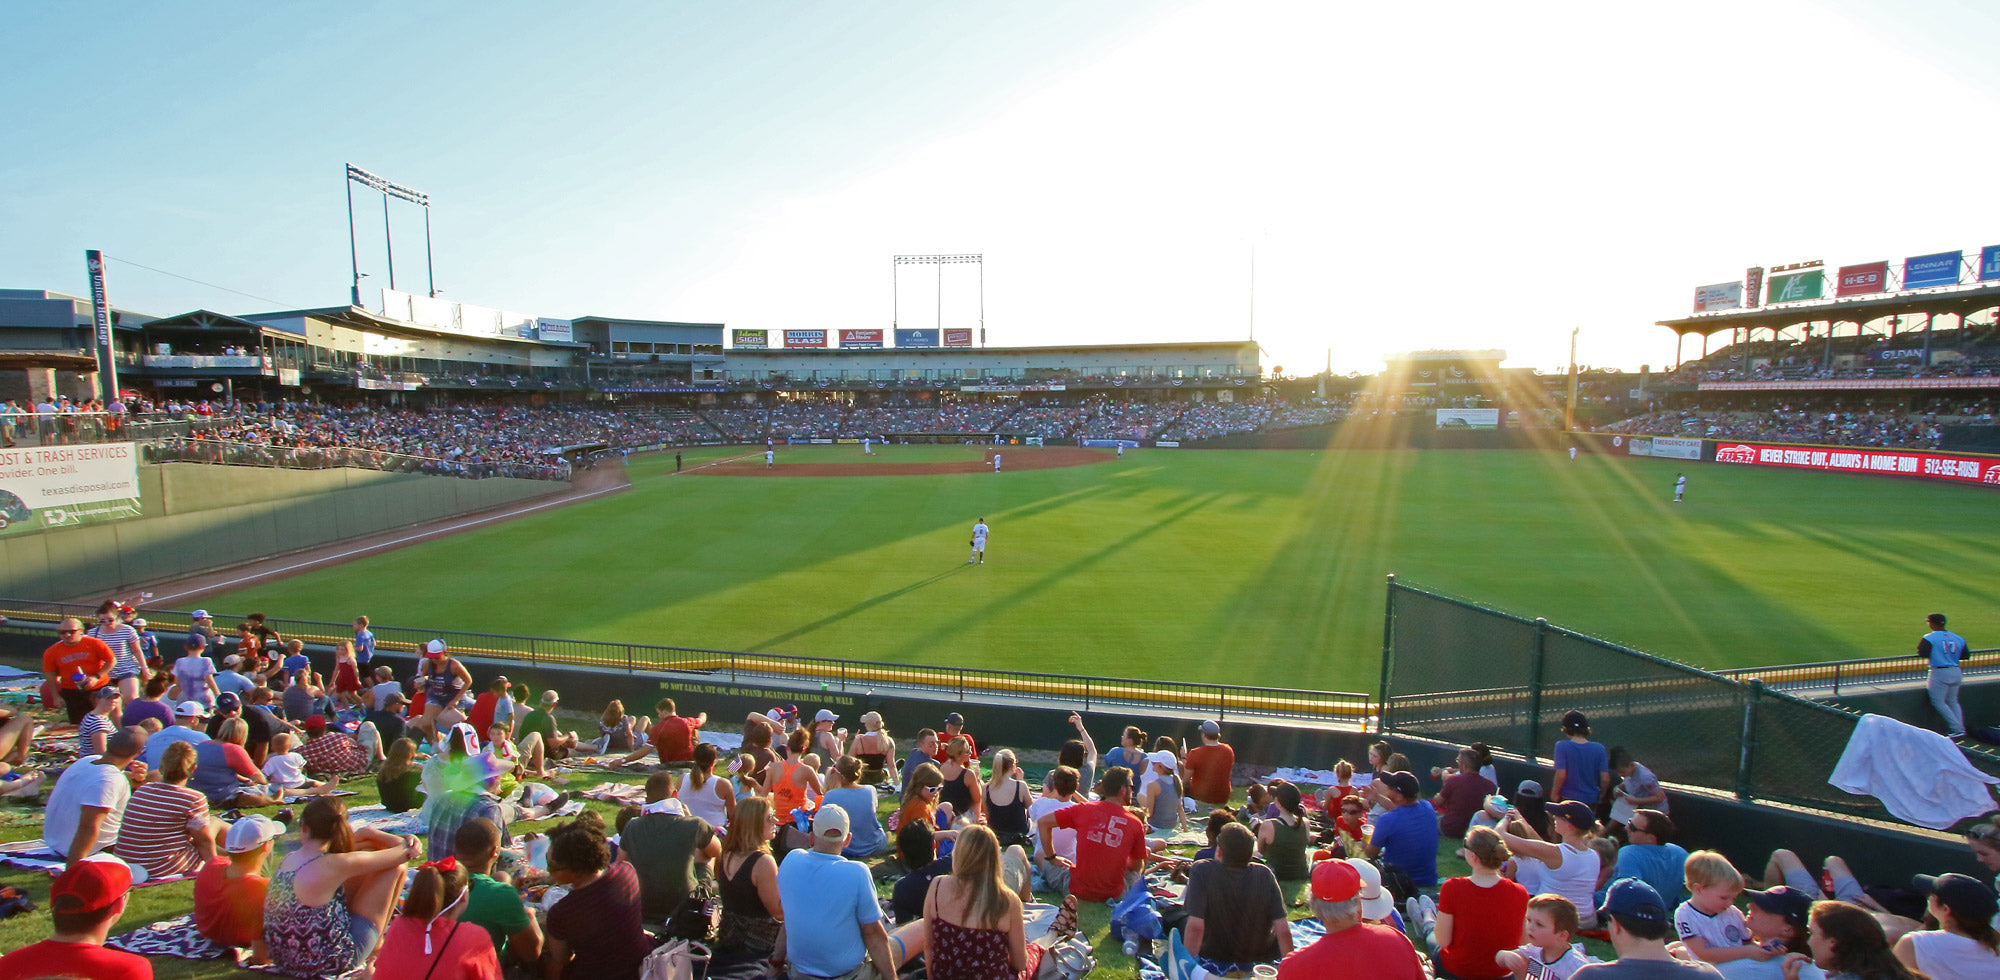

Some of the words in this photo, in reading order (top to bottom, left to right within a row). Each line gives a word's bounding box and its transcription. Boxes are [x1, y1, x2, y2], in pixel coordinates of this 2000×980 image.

[1908, 260, 1953, 270] LENNAR
[94, 275, 104, 304] United
[97, 306, 108, 345] Heritage
[1654, 439, 1685, 447] EMERGENCY
[25, 451, 33, 464] &
[37, 450, 74, 464] TRASH
[78, 447, 128, 460] SERVICES
[1760, 449, 1783, 464] NEVER
[1784, 450, 1810, 465] STRIKE
[1811, 451, 1828, 469] OUT,
[1830, 453, 1861, 469] ALWAYS
[1862, 455, 1869, 469] A
[1870, 455, 1897, 470] HOME
[1898, 457, 1918, 472] RUN
[1924, 459, 1979, 478] 512-SEE-RUSH
[37, 467, 58, 476] One
[61, 465, 78, 475] bill.
[42, 481, 131, 496] texasdisposal.com
[670, 683, 684, 691] NOT
[684, 684, 703, 693] LEAN,
[705, 685, 715, 693] SIT
[717, 687, 729, 696] ON,
[740, 689, 762, 697] STAND
[765, 691, 792, 699] AGAINST
[794, 693, 822, 702] RAILING
[823, 695, 833, 703] OR
[836, 696, 854, 705] WALL
[1086, 816, 1128, 848] 25
